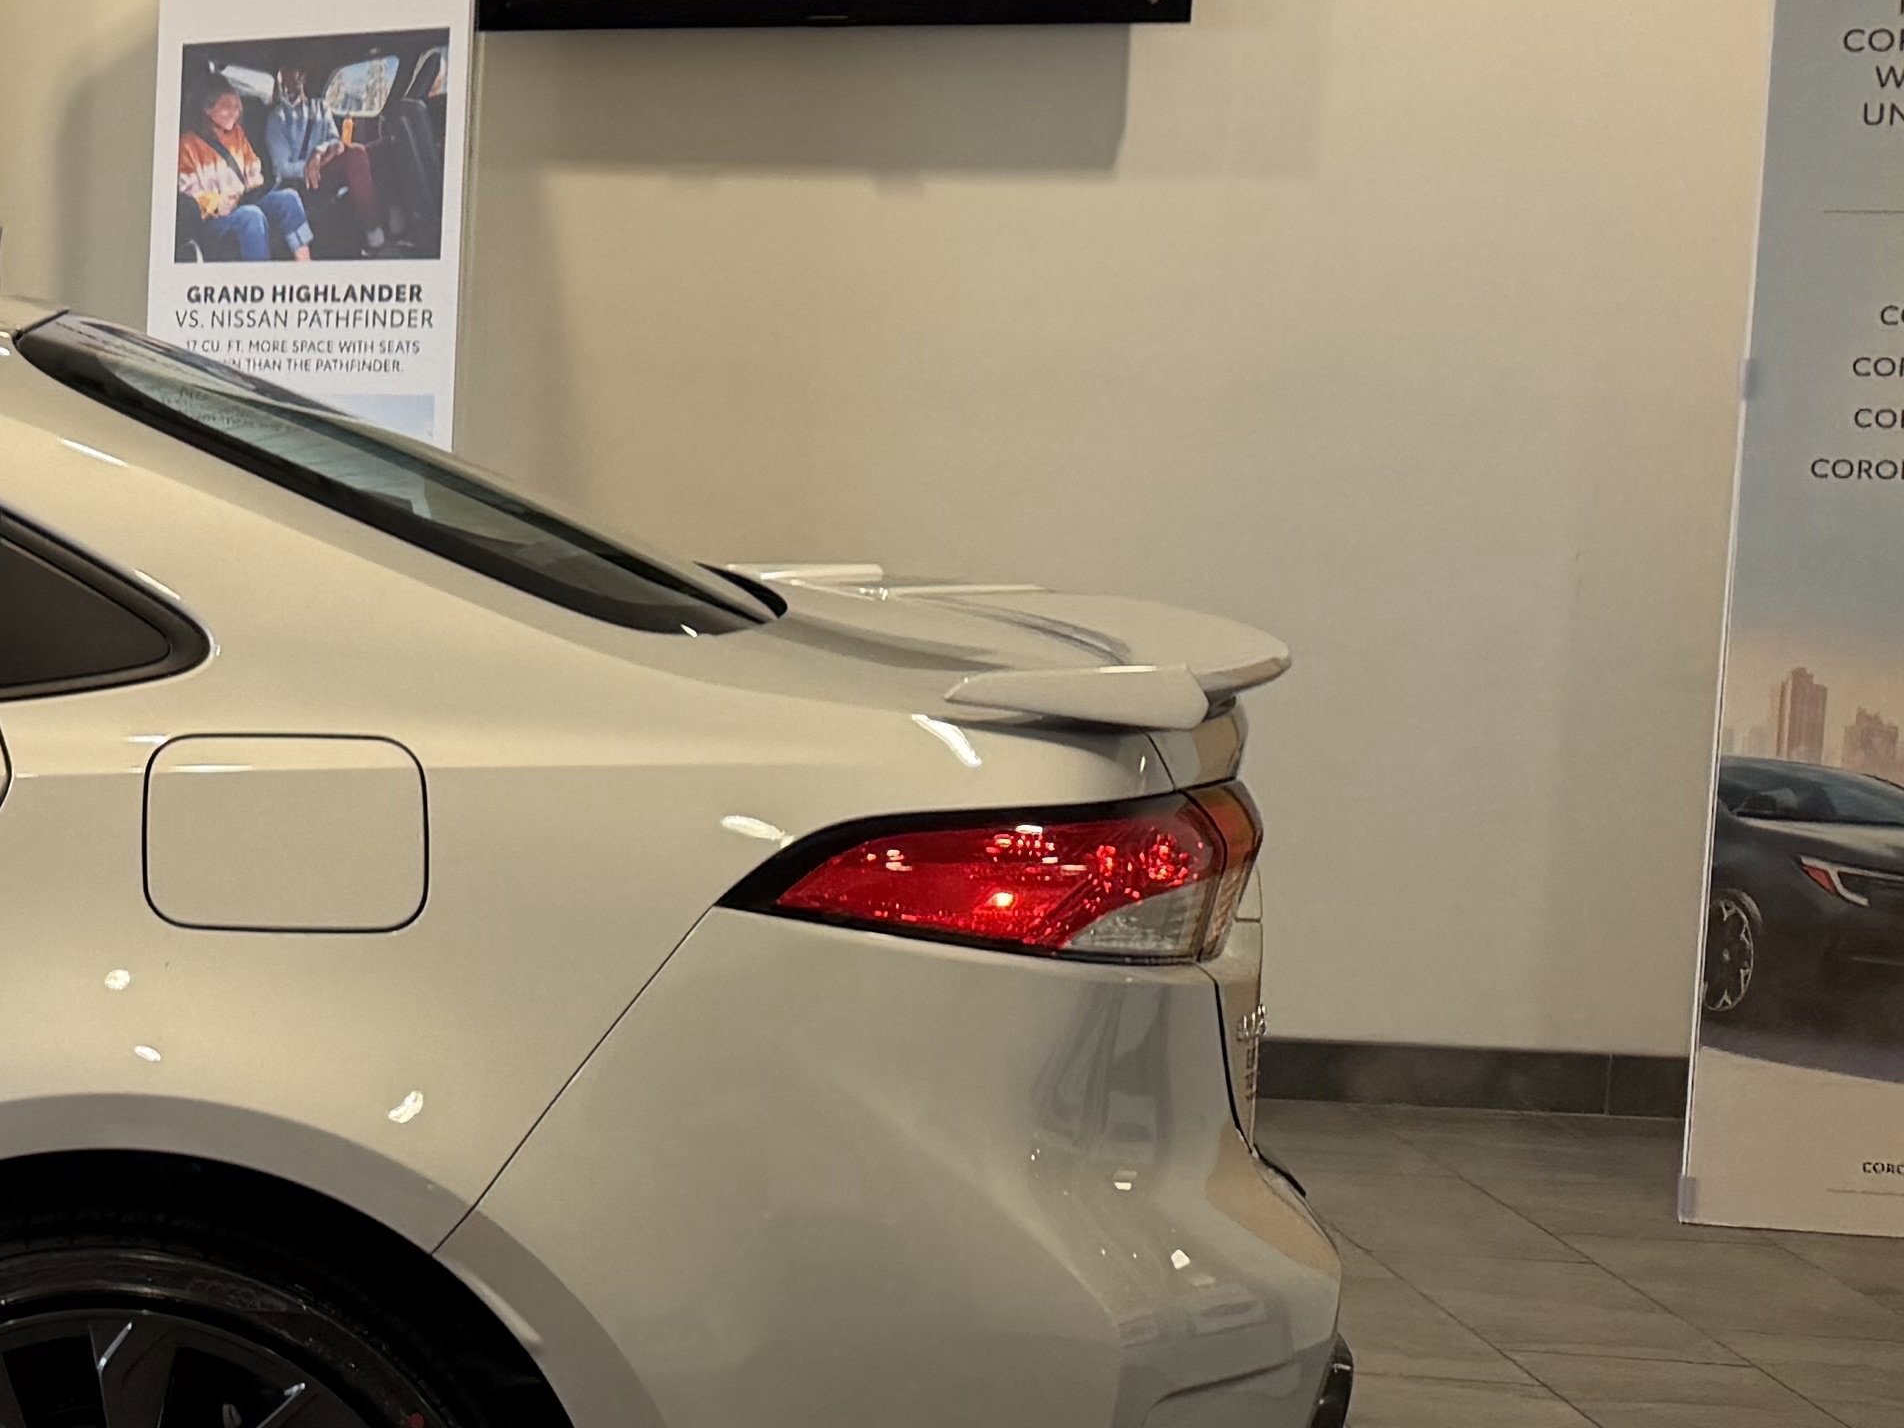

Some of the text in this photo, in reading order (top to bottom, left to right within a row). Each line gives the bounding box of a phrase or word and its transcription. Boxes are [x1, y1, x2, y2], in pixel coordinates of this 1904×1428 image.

[1843, 28, 1904, 52] CO
[186, 284, 423, 304] GRAND HIGHLANDER
[175, 309, 434, 329] VS. NISSAN PATHFINDER
[248, 339, 288, 353] MORE
[292, 339, 333, 354] SPACE
[339, 339, 374, 354] WITH
[379, 339, 420, 354] SEATS
[246, 357, 282, 372] THAN
[287, 358, 312, 372] THE
[1854, 408, 1904, 429] CO
[1811, 458, 1904, 480] CORO
